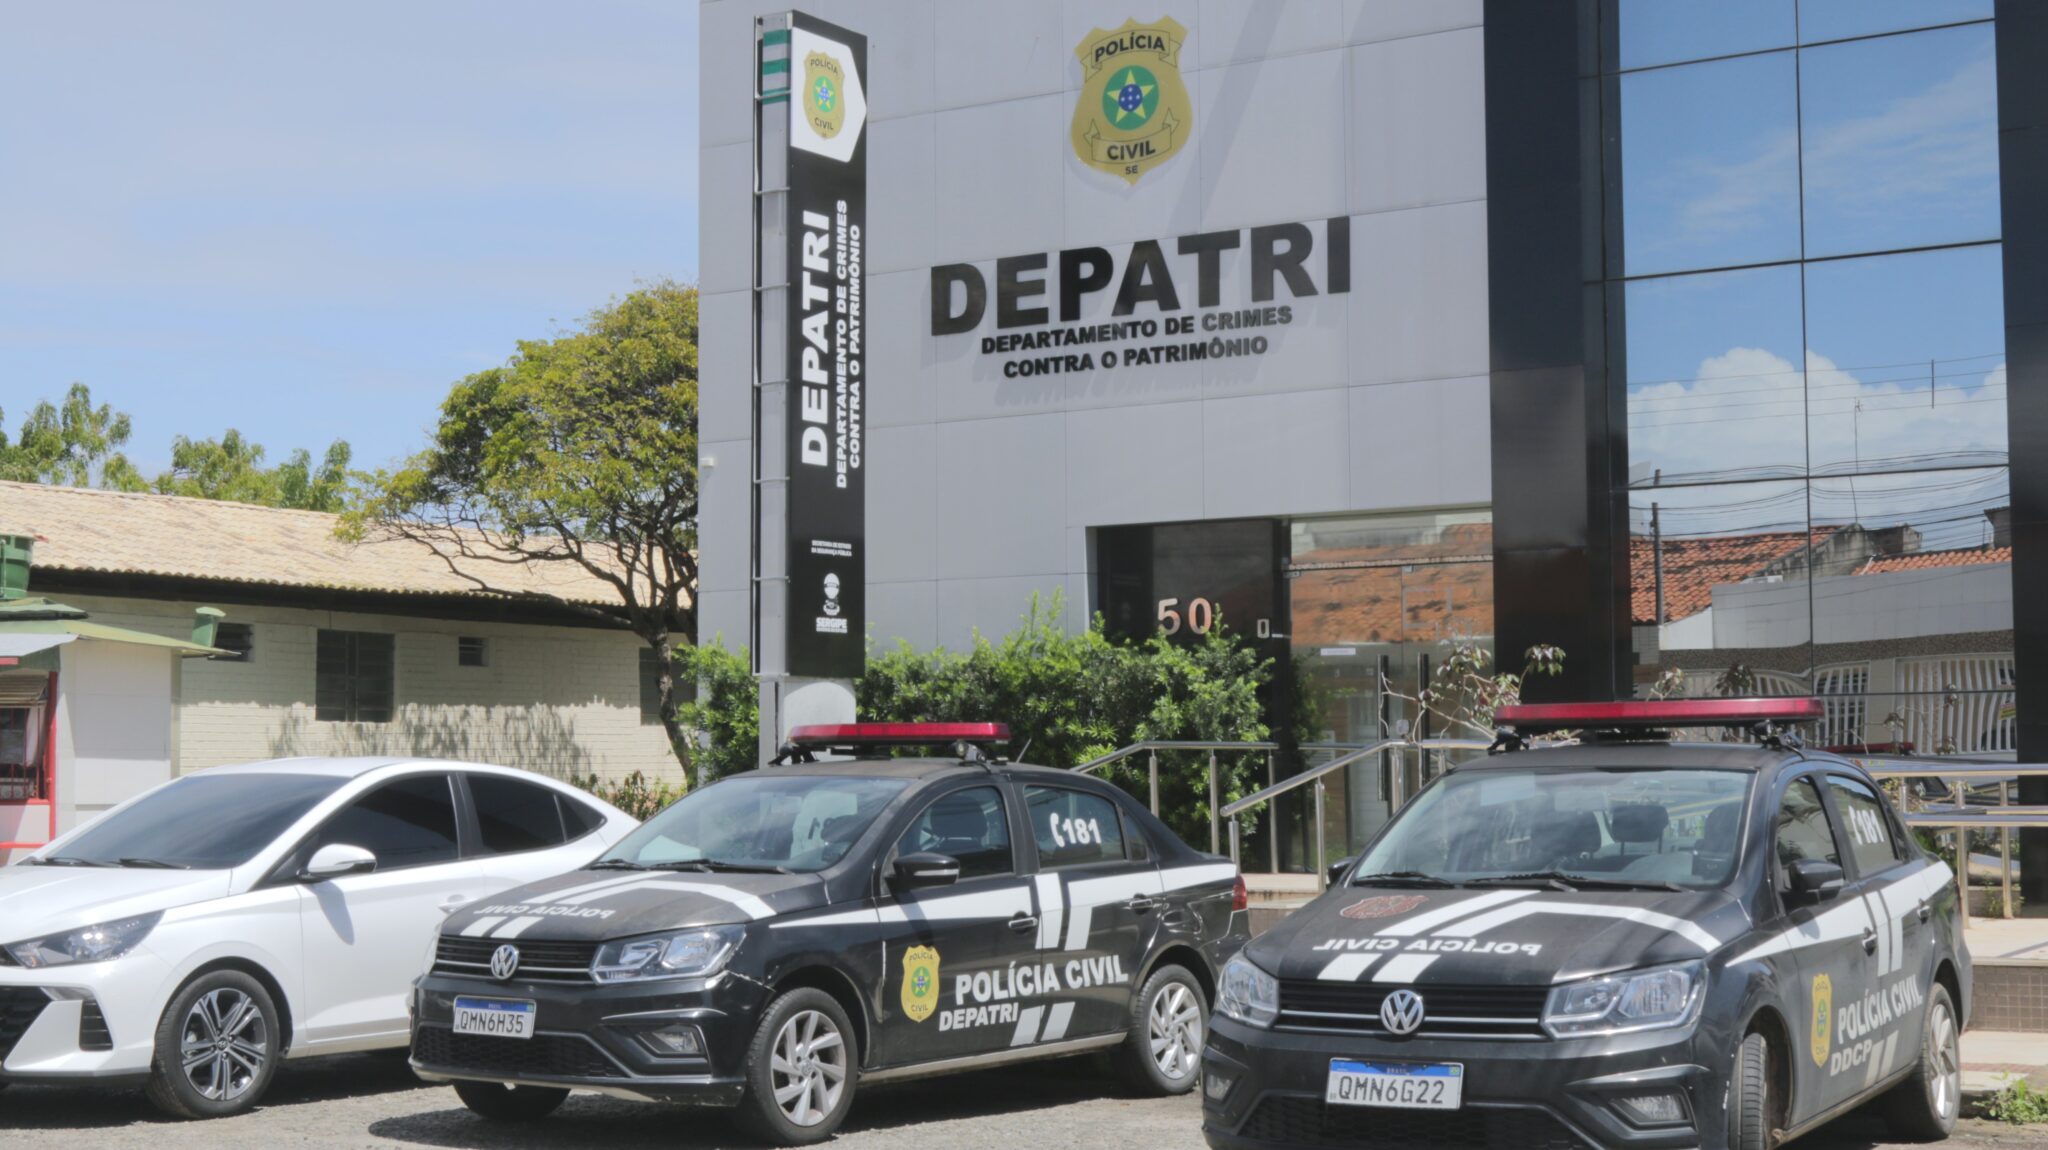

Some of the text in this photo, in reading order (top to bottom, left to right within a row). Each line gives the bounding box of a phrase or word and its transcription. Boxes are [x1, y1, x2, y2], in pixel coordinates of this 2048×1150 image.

[1095, 31, 1166, 62] POLÍCIA
[814, 117, 834, 130] CIVIL
[1107, 141, 1156, 160] CIVIL
[1125, 165, 1138, 175] SE
[931, 215, 1351, 336] DEPATRI
[802, 209, 829, 466] DEPATRI
[836, 200, 847, 488] DEPARTAMENTO DE CRIMES
[847, 224, 860, 469] CONTRA O PATRIMÔNIO
[981, 305, 1293, 354] DEPARTAMENTO DE CRIMES
[1003, 336, 1269, 379] CONTRA O PATRIMÔNIO
[1157, 597, 1212, 636] 50
[1062, 818, 1102, 845] 181
[1856, 809, 1885, 844] 181
[955, 954, 1129, 1006] POLÍCIA CIVIL
[460, 1010, 525, 1034] QMN6H35
[938, 1002, 1019, 1032] DEPATRI
[1837, 973, 1923, 1045] POLÍCIA CIVIL
[1830, 1038, 1873, 1077] DDCP
[1338, 1075, 1446, 1105] QMN6G22
